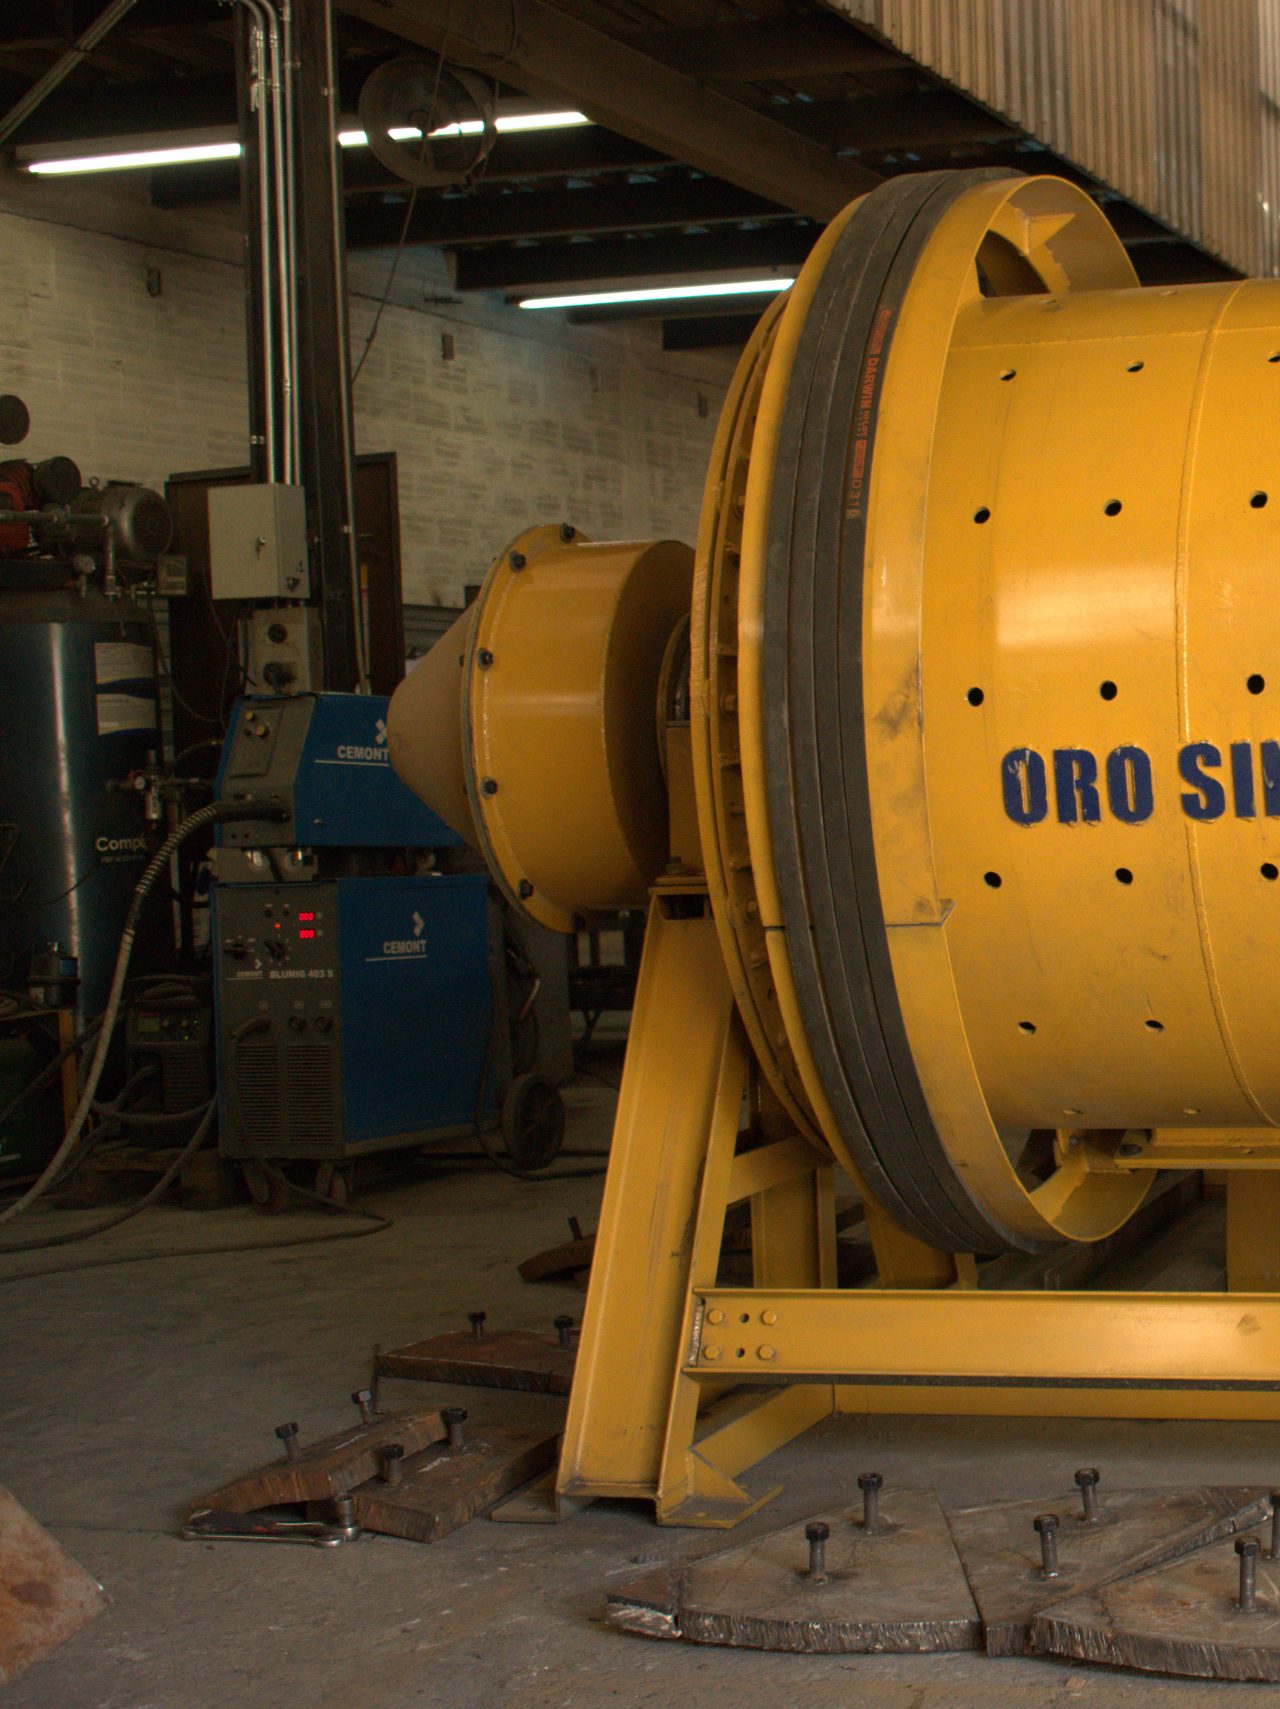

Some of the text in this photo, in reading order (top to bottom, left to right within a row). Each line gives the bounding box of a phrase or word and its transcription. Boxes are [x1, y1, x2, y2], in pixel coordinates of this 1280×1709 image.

[336, 745, 390, 761] CEMONT
[1001, 743, 1155, 826] ORO
[96, 835, 149, 853] Comp
[382, 940, 427, 954] CEMONT
